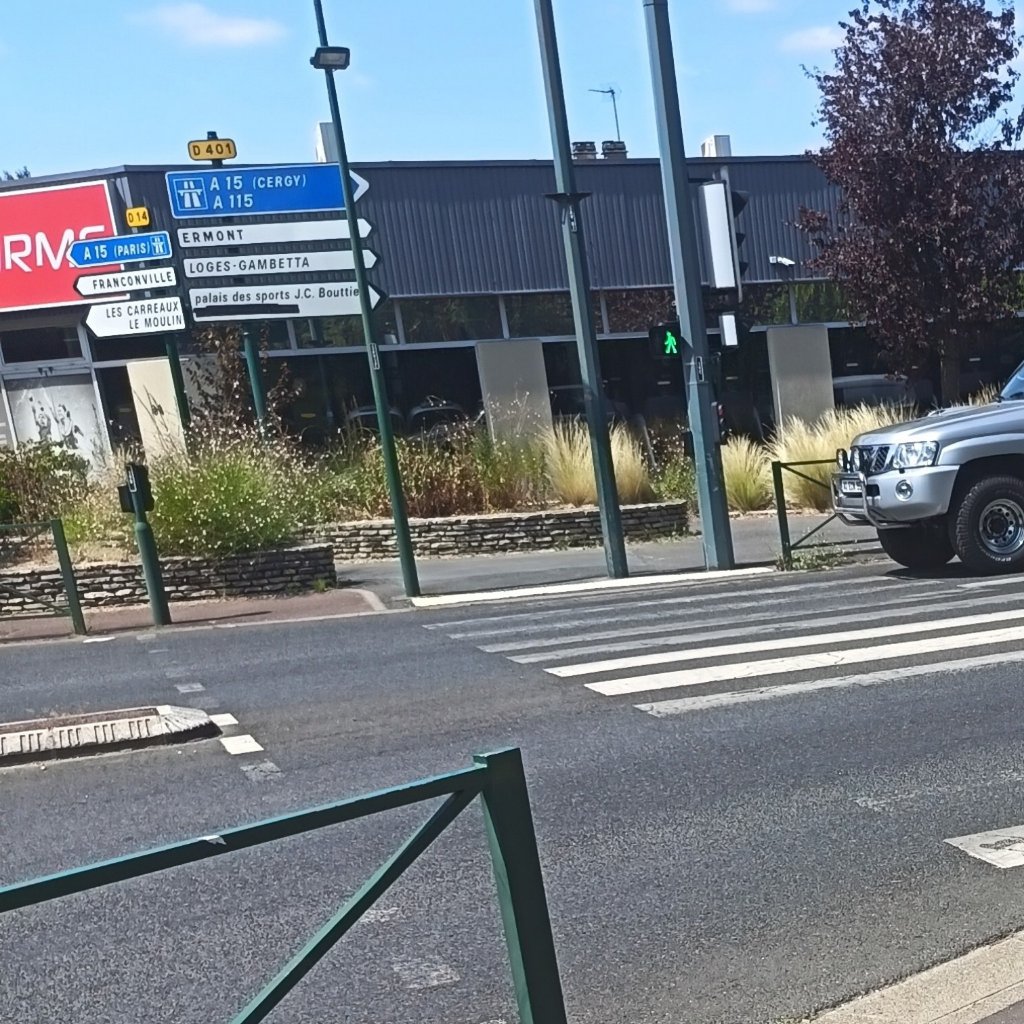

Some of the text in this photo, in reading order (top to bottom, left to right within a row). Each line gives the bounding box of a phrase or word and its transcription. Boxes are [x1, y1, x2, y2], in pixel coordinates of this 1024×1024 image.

[192, 143, 232, 156] D 401
[210, 174, 307, 191] A 15 (CERGY)
[213, 193, 254, 209] A 115
[128, 210, 148, 223] D 14
[182, 229, 244, 243] ERMONT
[84, 241, 150, 260] A 15 (PARIS)
[189, 257, 310, 274] LOGES-GAMBETTA
[92, 271, 173, 290] FRANCONVILLE
[195, 291, 228, 305] palais
[232, 290, 251, 302] des
[255, 289, 290, 305] sports
[294, 287, 315, 299] J.C.
[106, 301, 179, 318] LES CARREAUX
[129, 314, 182, 330] LE MOULIN
